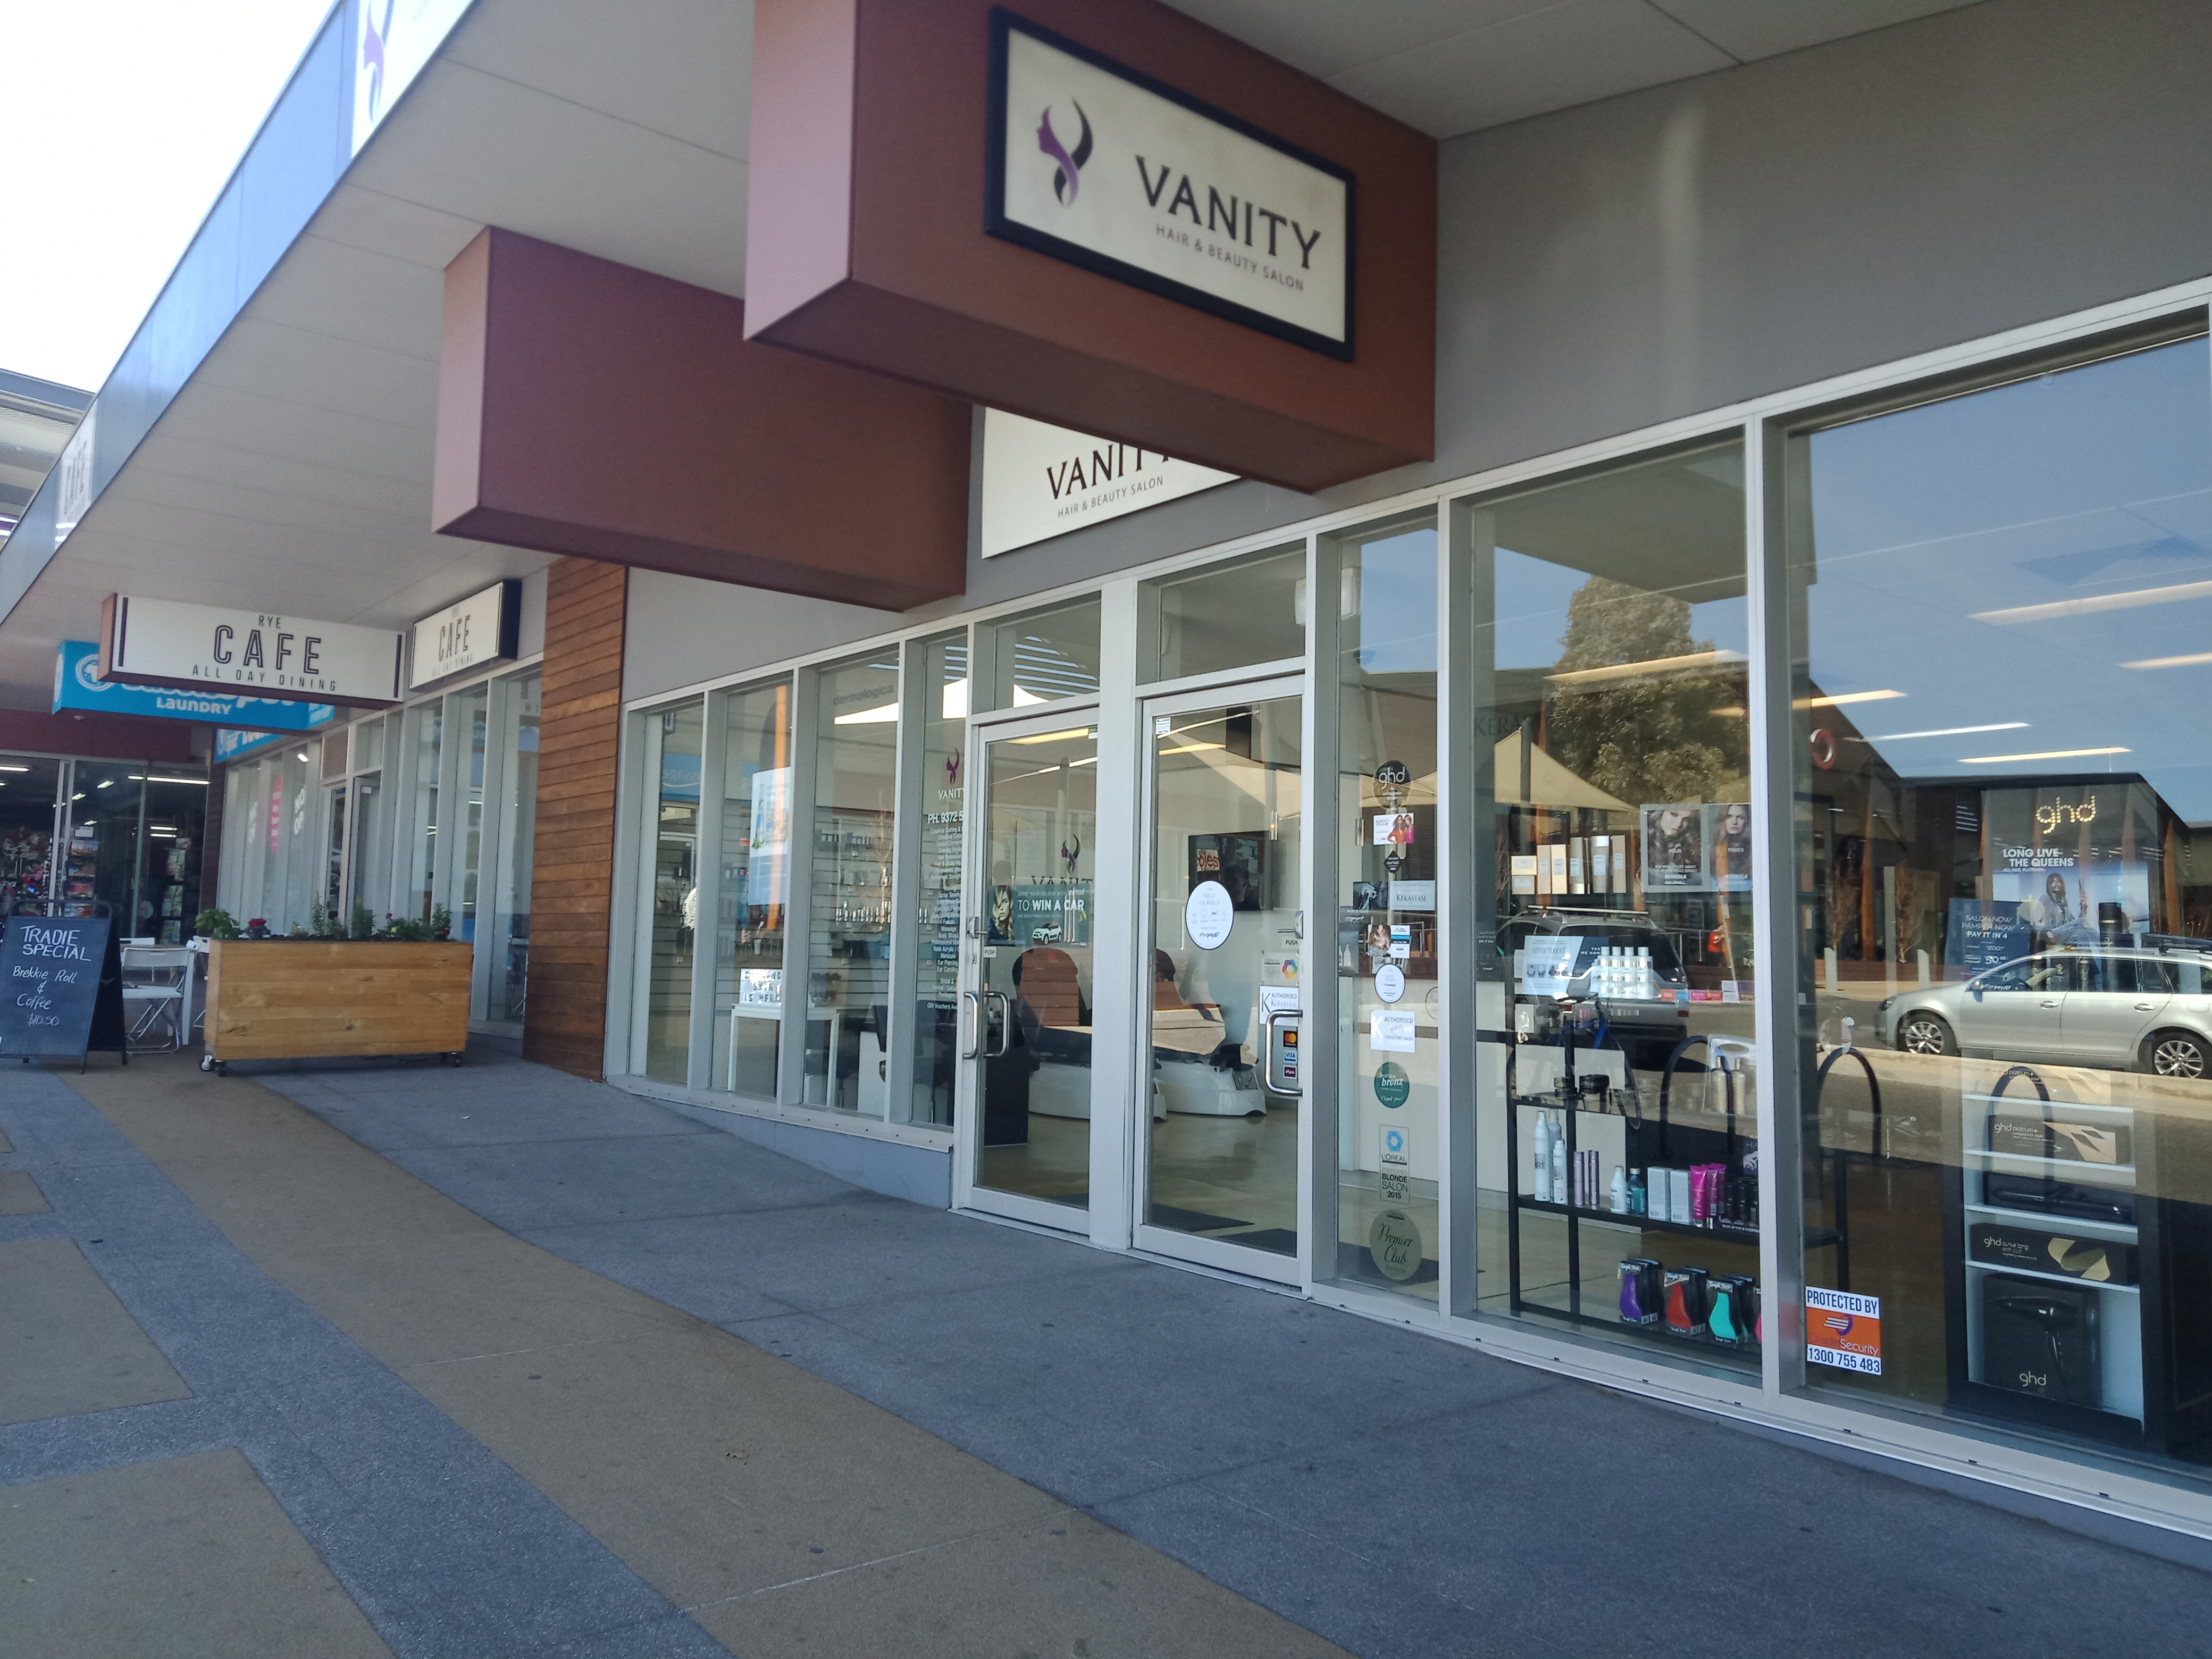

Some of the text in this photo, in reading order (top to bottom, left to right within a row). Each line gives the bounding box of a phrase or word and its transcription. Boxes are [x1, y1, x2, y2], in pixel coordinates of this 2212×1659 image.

[1134, 154, 1321, 270] VANITY
[1156, 223, 1304, 292] HAIR & BEAUTY SALON
[1058, 475, 1163, 518] HAIR & BEAUTY SALON
[258, 615, 282, 630] RYE
[439, 614, 470, 661] CAFE
[213, 624, 322, 675] CAFE
[192, 664, 336, 691] ALL DAY DINING
[1378, 766, 1405, 790] ghd
[939, 787, 963, 800] VANIT
[928, 814, 940, 824] PH.
[941, 812, 958, 824] 9372
[2035, 794, 2097, 835] ghd
[2002, 848, 2059, 858] LONG LIVE
[2009, 857, 2074, 867] THE QUEENS
[1017, 899, 1085, 911] TO WIN A CAR
[20, 925, 81, 947] TRADIE
[22, 944, 92, 962] SPECIAL
[1531, 946, 1566, 954] smartbond
[13, 965, 78, 984] Brekkie Roll
[37, 980, 47, 995] &
[16, 993, 52, 1010] Coffee
[1381, 1077, 1404, 1087] bronz
[1994, 1122, 2013, 1133] ghd
[1382, 1167, 1408, 1176] PREFERRED
[1382, 1172, 1408, 1183] BLONDE
[1381, 1180, 1408, 1192] SALON
[1387, 1190, 1402, 1200] 2015
[1378, 1222, 1414, 1247] Premier
[1984, 1236, 2001, 1247] ghd
[1384, 1244, 1407, 1264] Club
[1807, 1289, 1878, 1314] PROTECTED BY
[1840, 1338, 1879, 1356] Security
[1808, 1347, 1880, 1373] 1300 755 483
[2019, 1370, 2047, 1387] ghd
